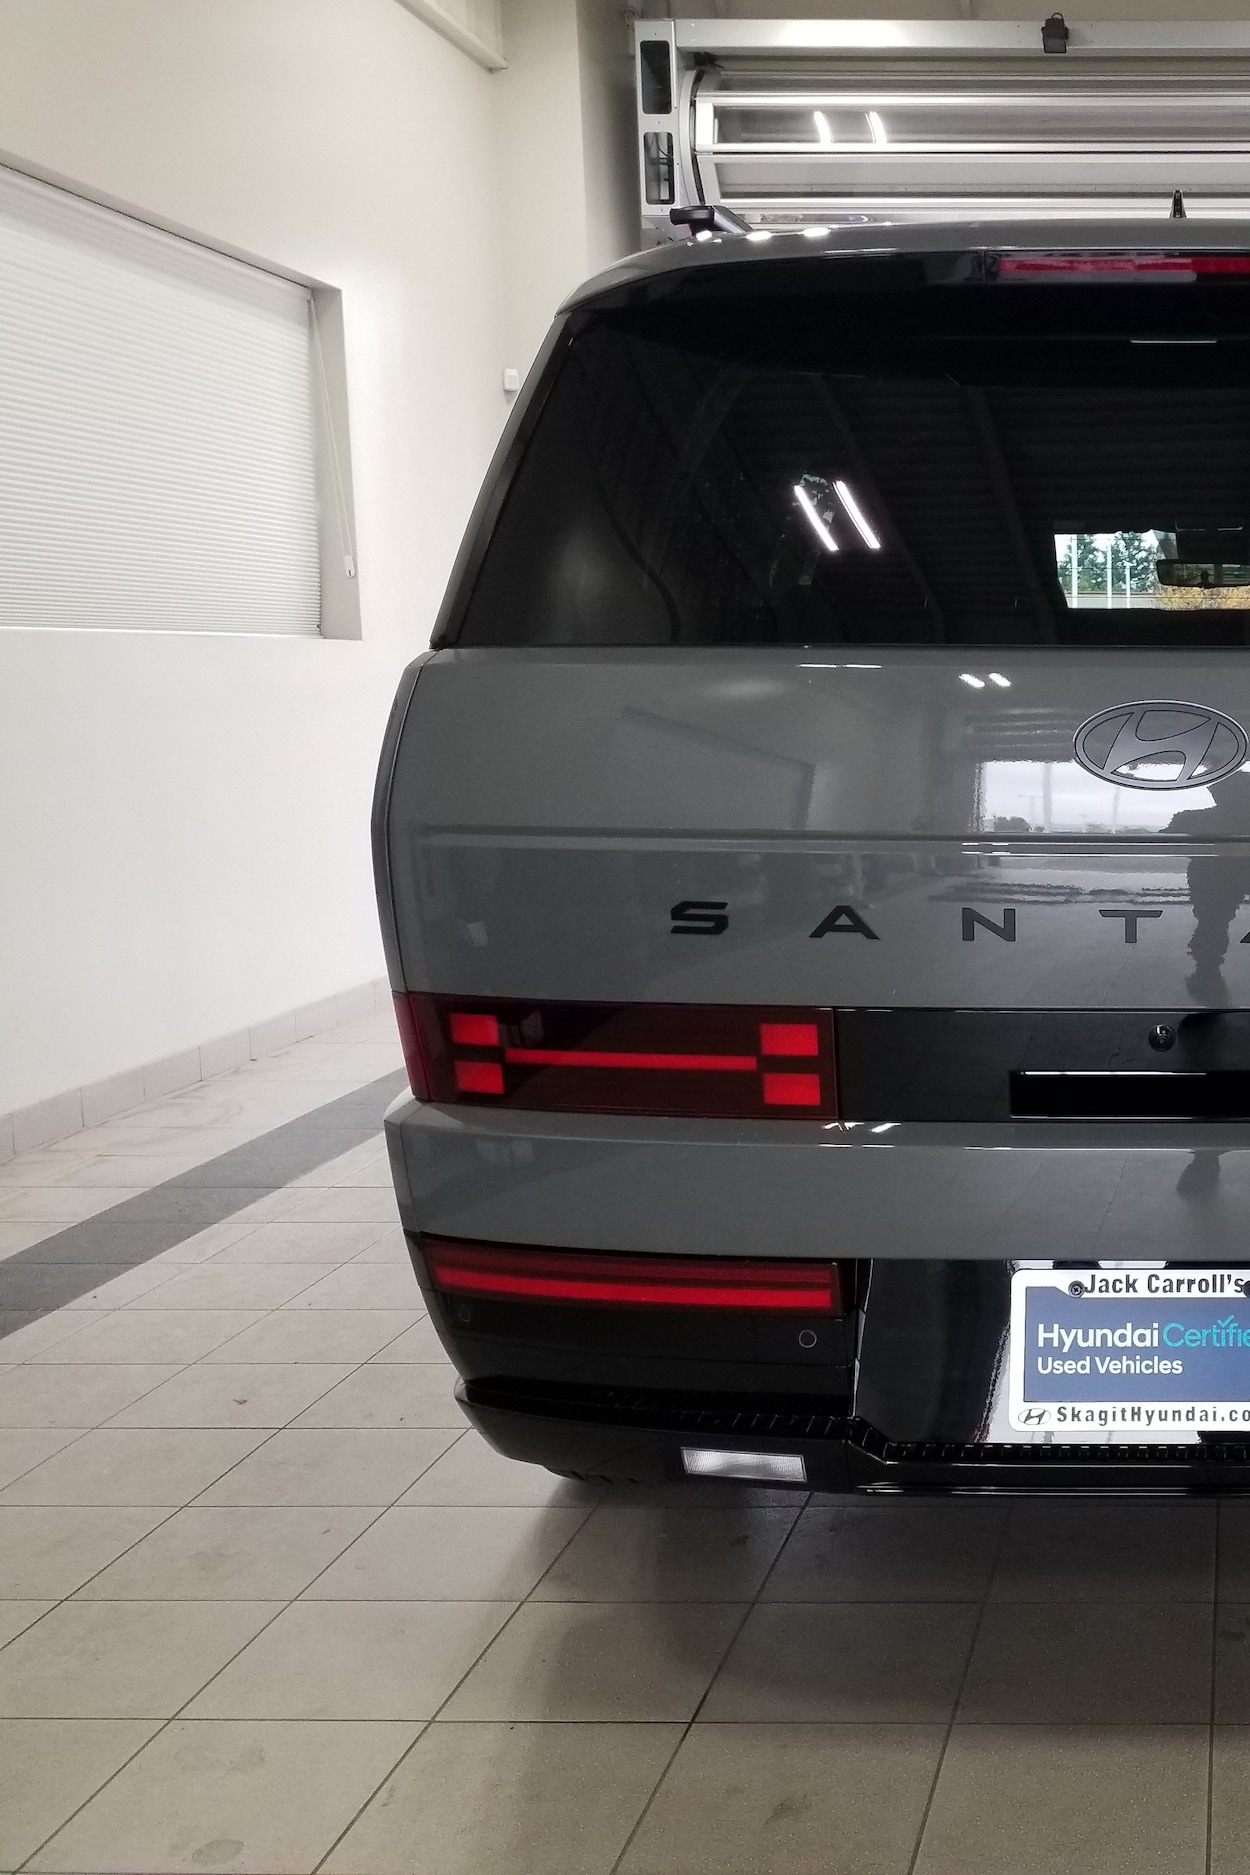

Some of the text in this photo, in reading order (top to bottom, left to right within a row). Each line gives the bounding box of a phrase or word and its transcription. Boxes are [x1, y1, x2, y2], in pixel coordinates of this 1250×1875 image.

[1084, 1273, 1246, 1294] Jack Carroll's
[1037, 1322, 1160, 1353] Hyundai
[1037, 1356, 1184, 1375] Used Vehicles
